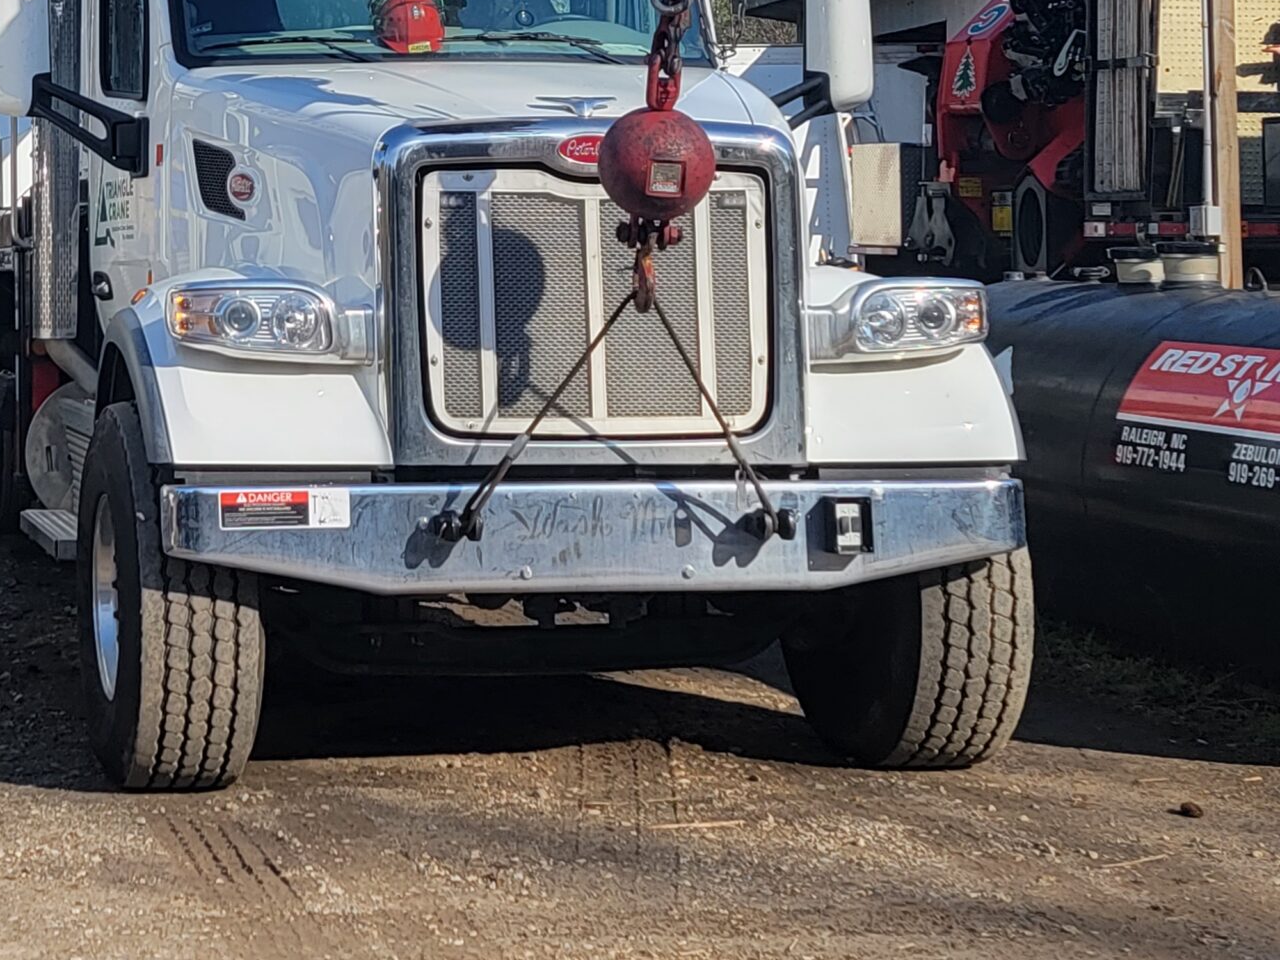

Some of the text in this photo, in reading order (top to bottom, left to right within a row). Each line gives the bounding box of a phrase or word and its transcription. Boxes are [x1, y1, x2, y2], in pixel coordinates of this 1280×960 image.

[105, 179, 134, 199] TRIANGLE
[109, 200, 130, 221] CRANE
[1121, 426, 1188, 450] RALEIGH, NC
[1115, 444, 1186, 473] 919-772-1944
[248, 492, 293, 503] DANGER
